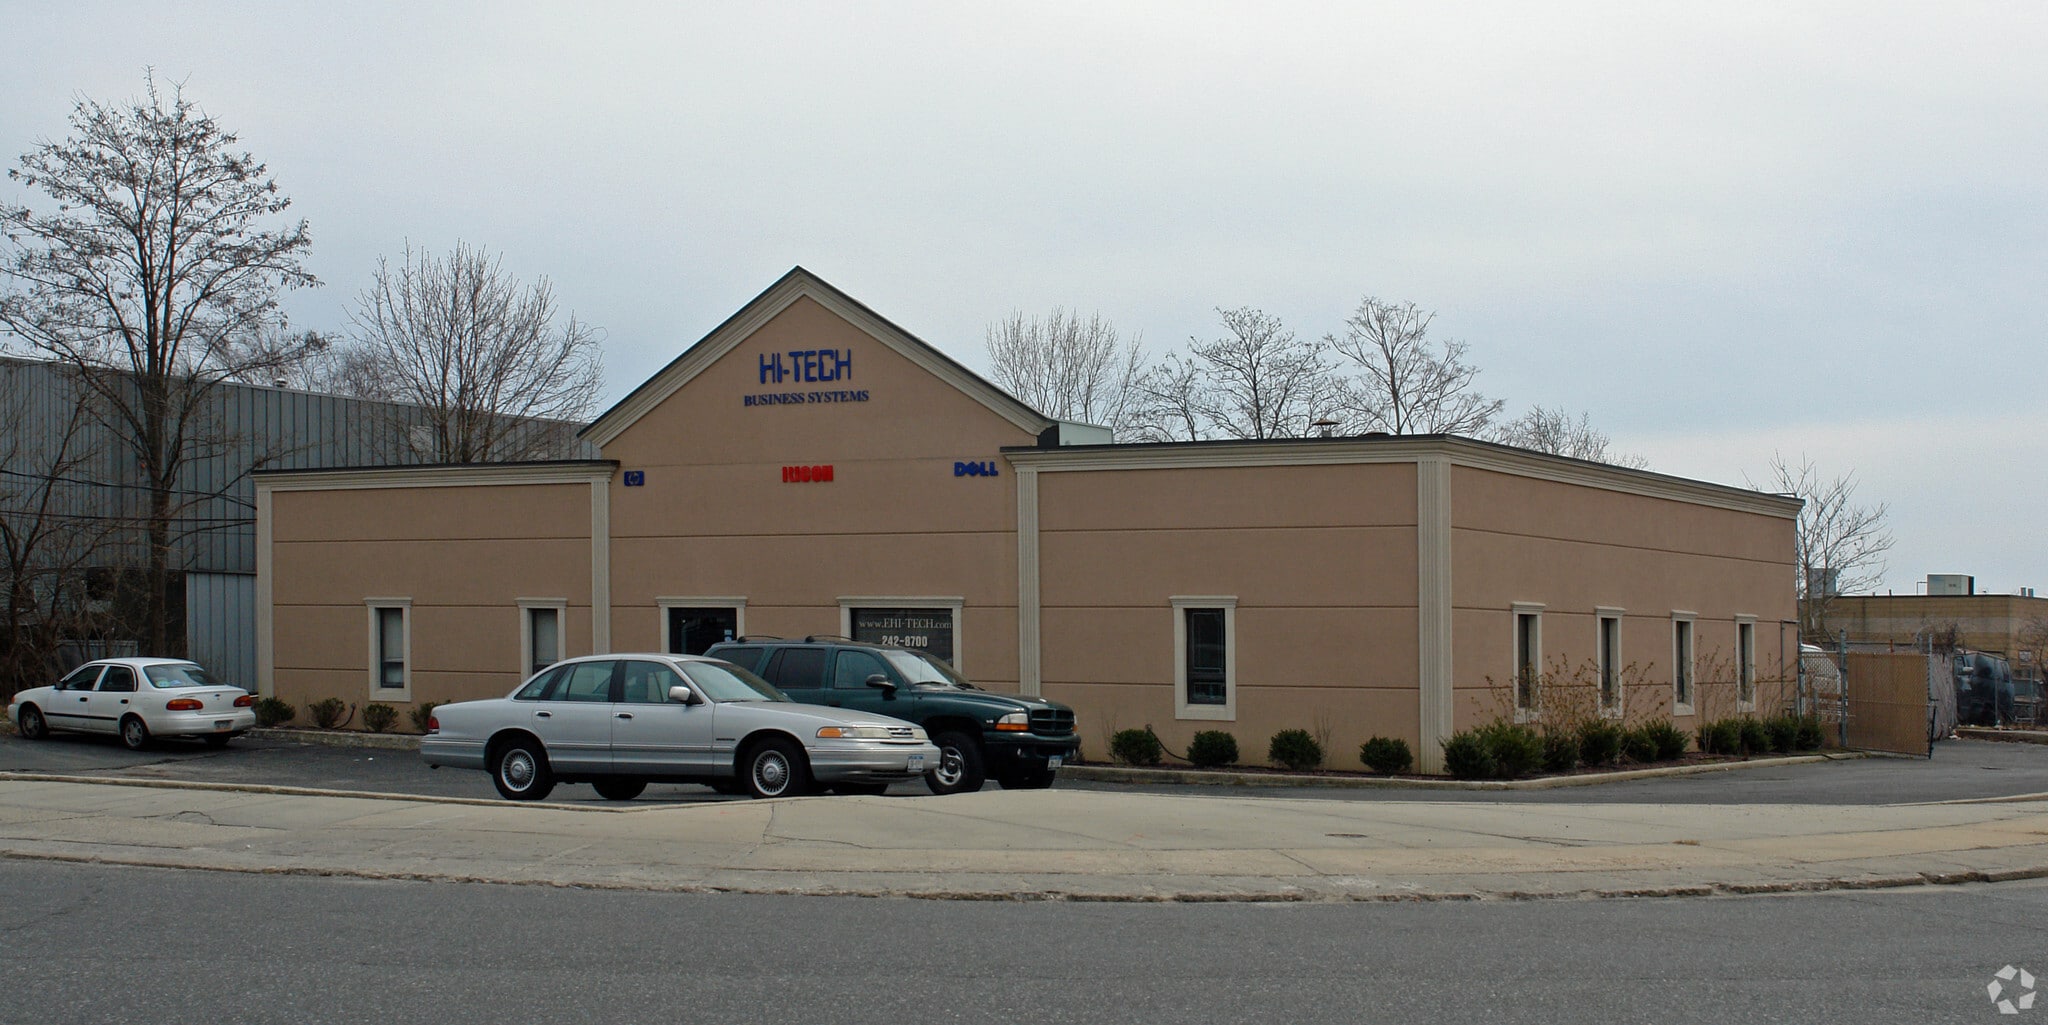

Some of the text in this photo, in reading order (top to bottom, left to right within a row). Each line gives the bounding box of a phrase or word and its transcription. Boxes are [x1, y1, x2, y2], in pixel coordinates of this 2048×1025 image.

[759, 349, 851, 384] HI-TECH
[744, 390, 869, 407] BUSINESS SYSTEMS
[882, 635, 928, 647] 242-8700
